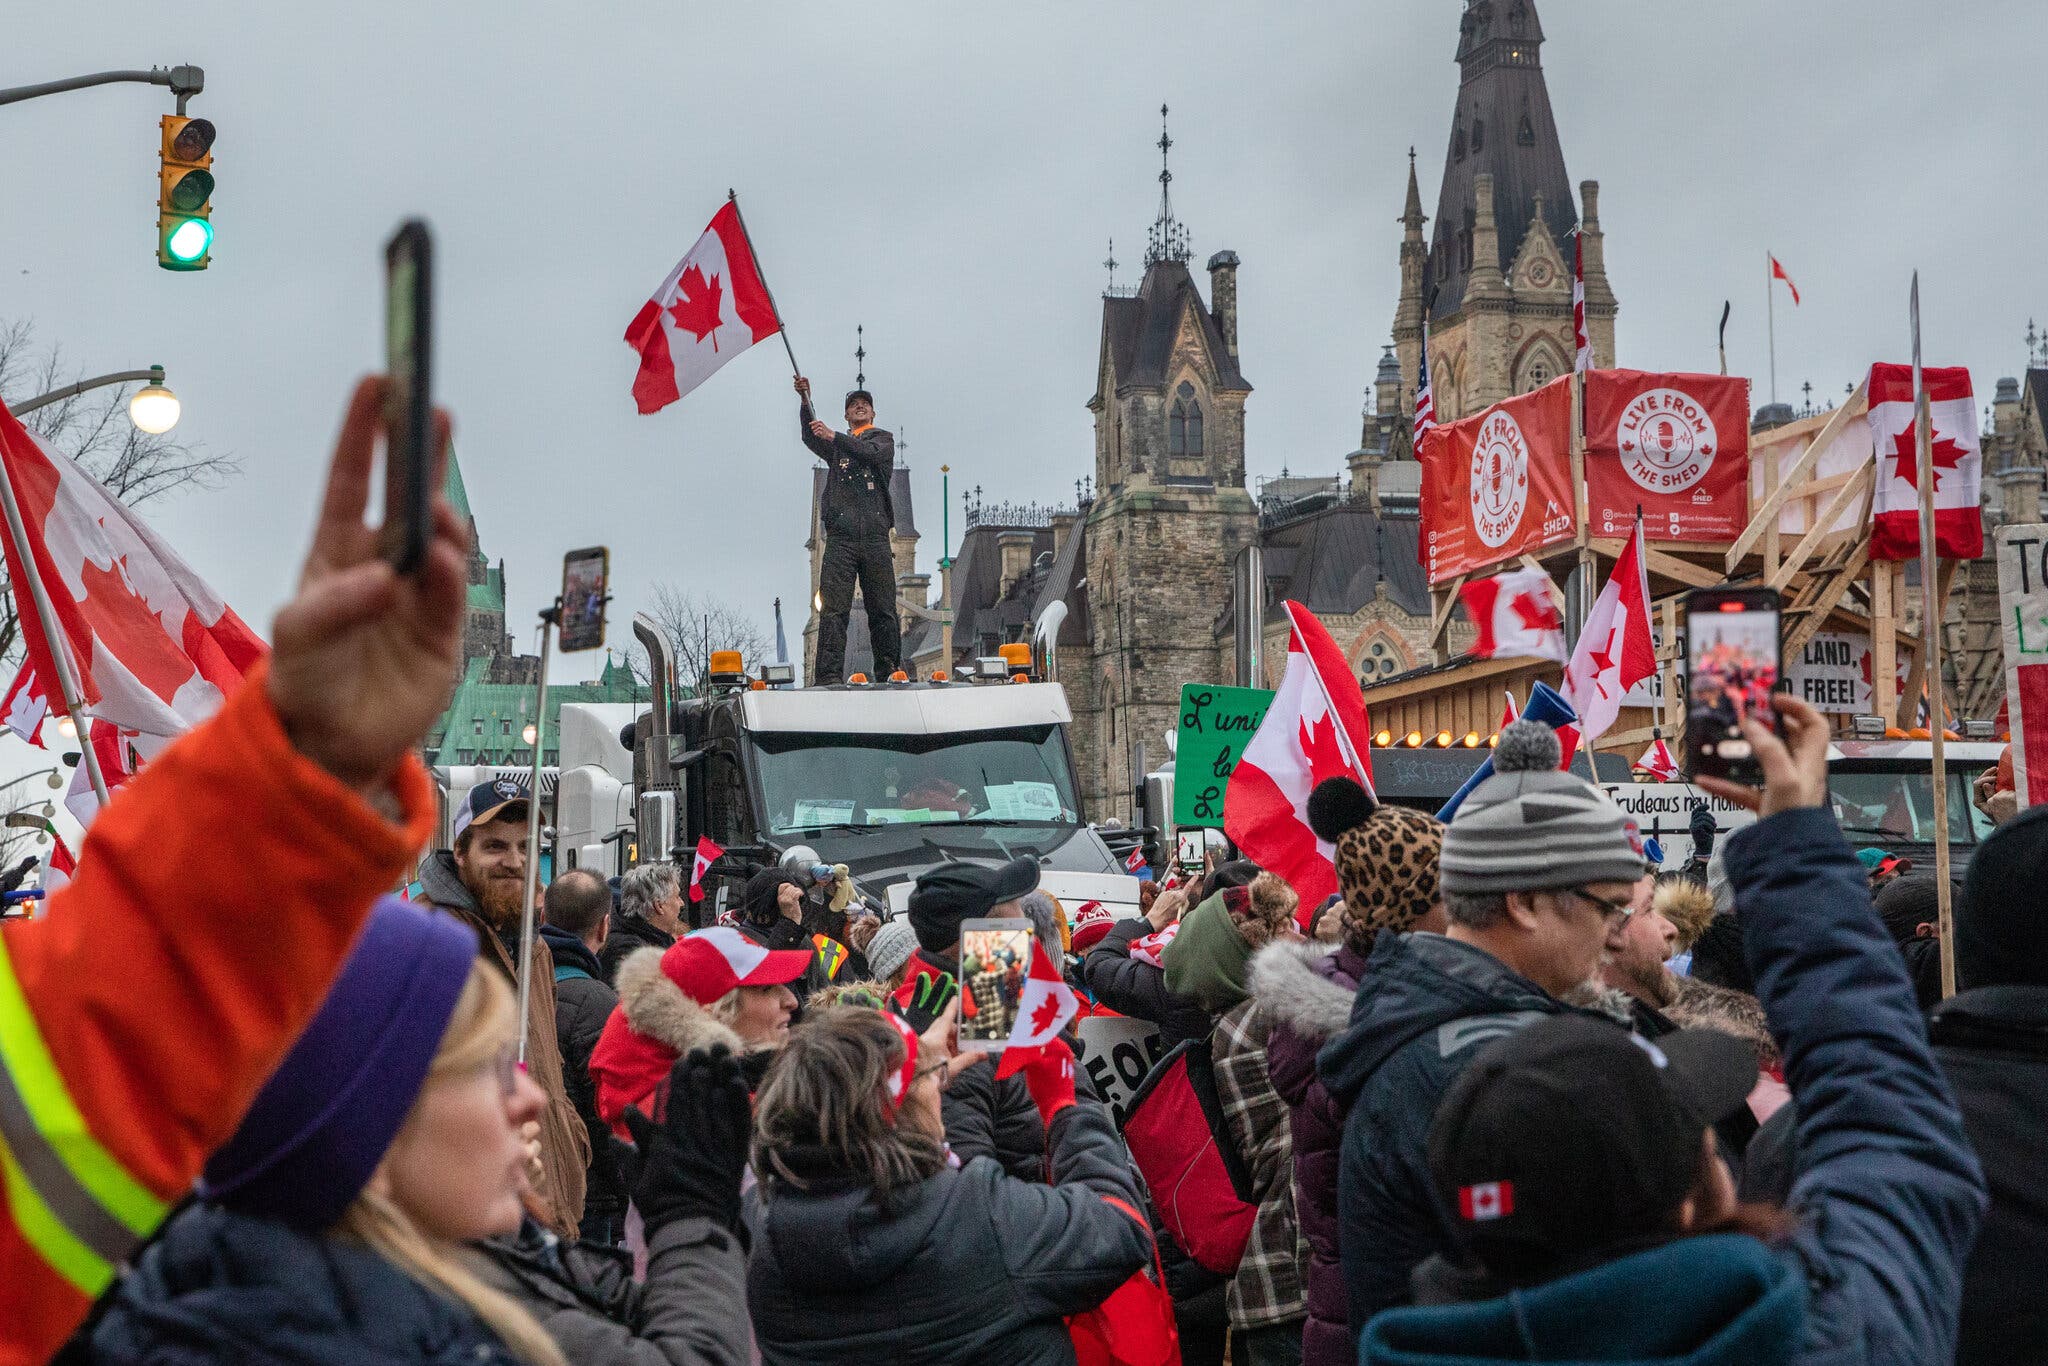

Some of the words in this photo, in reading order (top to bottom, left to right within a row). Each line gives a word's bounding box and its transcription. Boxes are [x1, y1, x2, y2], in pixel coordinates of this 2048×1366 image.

[1624, 395, 1659, 431] LIVE
[1663, 394, 1708, 434] FROM
[1474, 425, 1492, 475] LIVE
[1493, 417, 1522, 461] FROM
[1632, 459, 1658, 485] THE
[1661, 463, 1700, 487] SHED
[1478, 512, 1493, 538] THE
[1496, 501, 1520, 538] SHED
[1542, 515, 1571, 536] SHED
[1804, 640, 1857, 668] LAND,
[1804, 678, 1856, 705] FREE!
